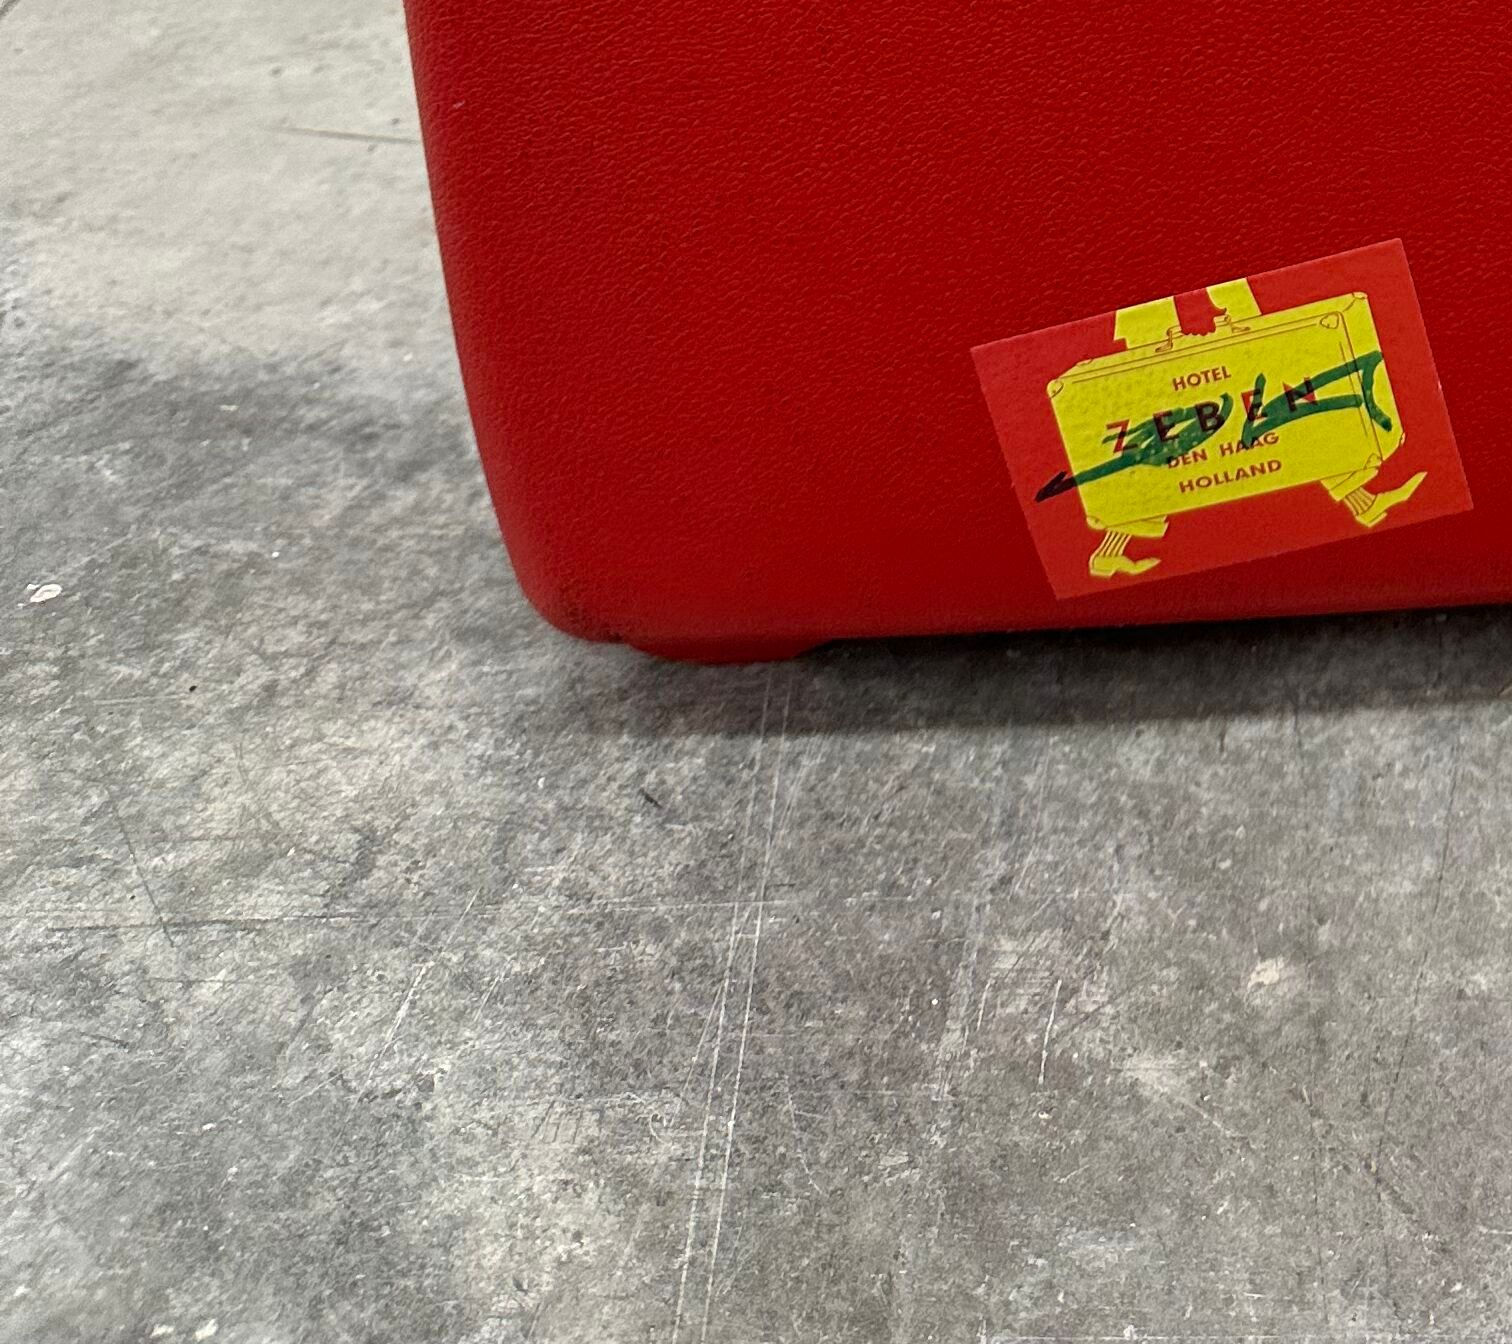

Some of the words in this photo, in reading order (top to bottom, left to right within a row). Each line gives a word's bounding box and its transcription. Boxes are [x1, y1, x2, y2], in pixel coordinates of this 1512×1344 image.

[1172, 365, 1232, 392] HOTEL
[1167, 449, 1208, 469] DEN
[1219, 431, 1280, 457] HAAG
[1178, 459, 1282, 494] HOLLAND
